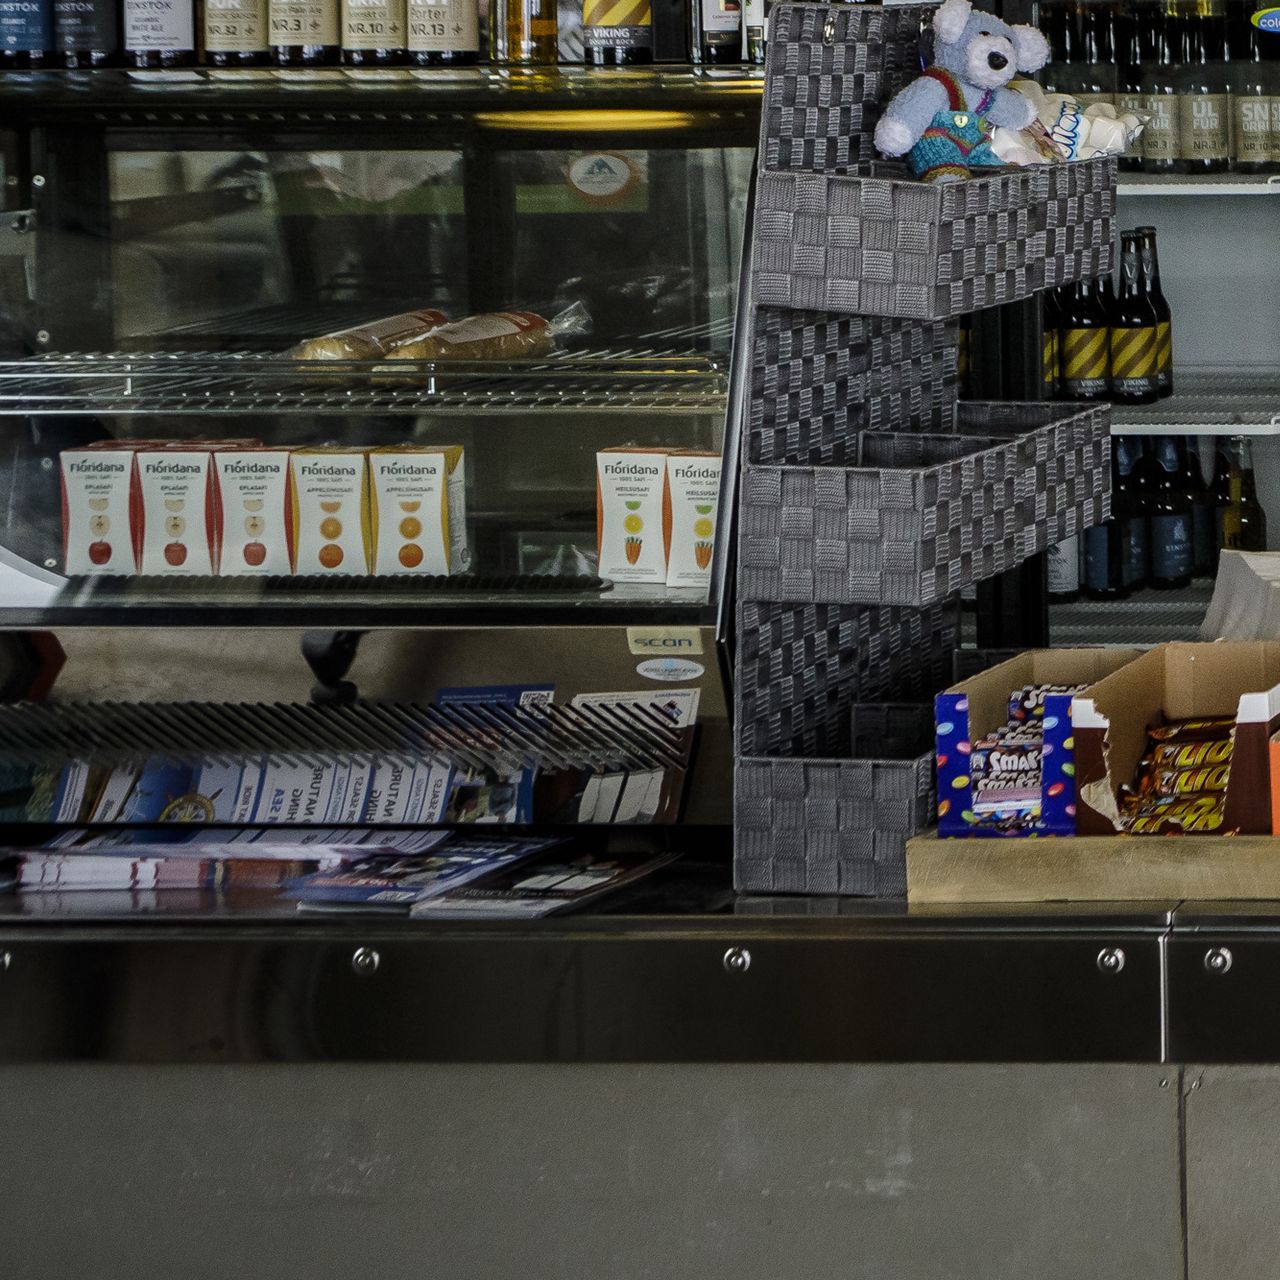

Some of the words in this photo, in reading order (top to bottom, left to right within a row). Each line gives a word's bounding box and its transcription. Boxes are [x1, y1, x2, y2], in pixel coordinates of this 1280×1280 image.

[272, 19, 301, 31] NR.3
[348, 23, 384, 35] NR.10
[410, 23, 445, 36] NR.13
[592, 27, 630, 38] VIKING
[1242, 102, 1269, 121] SN
[634, 638, 693, 647] scan
